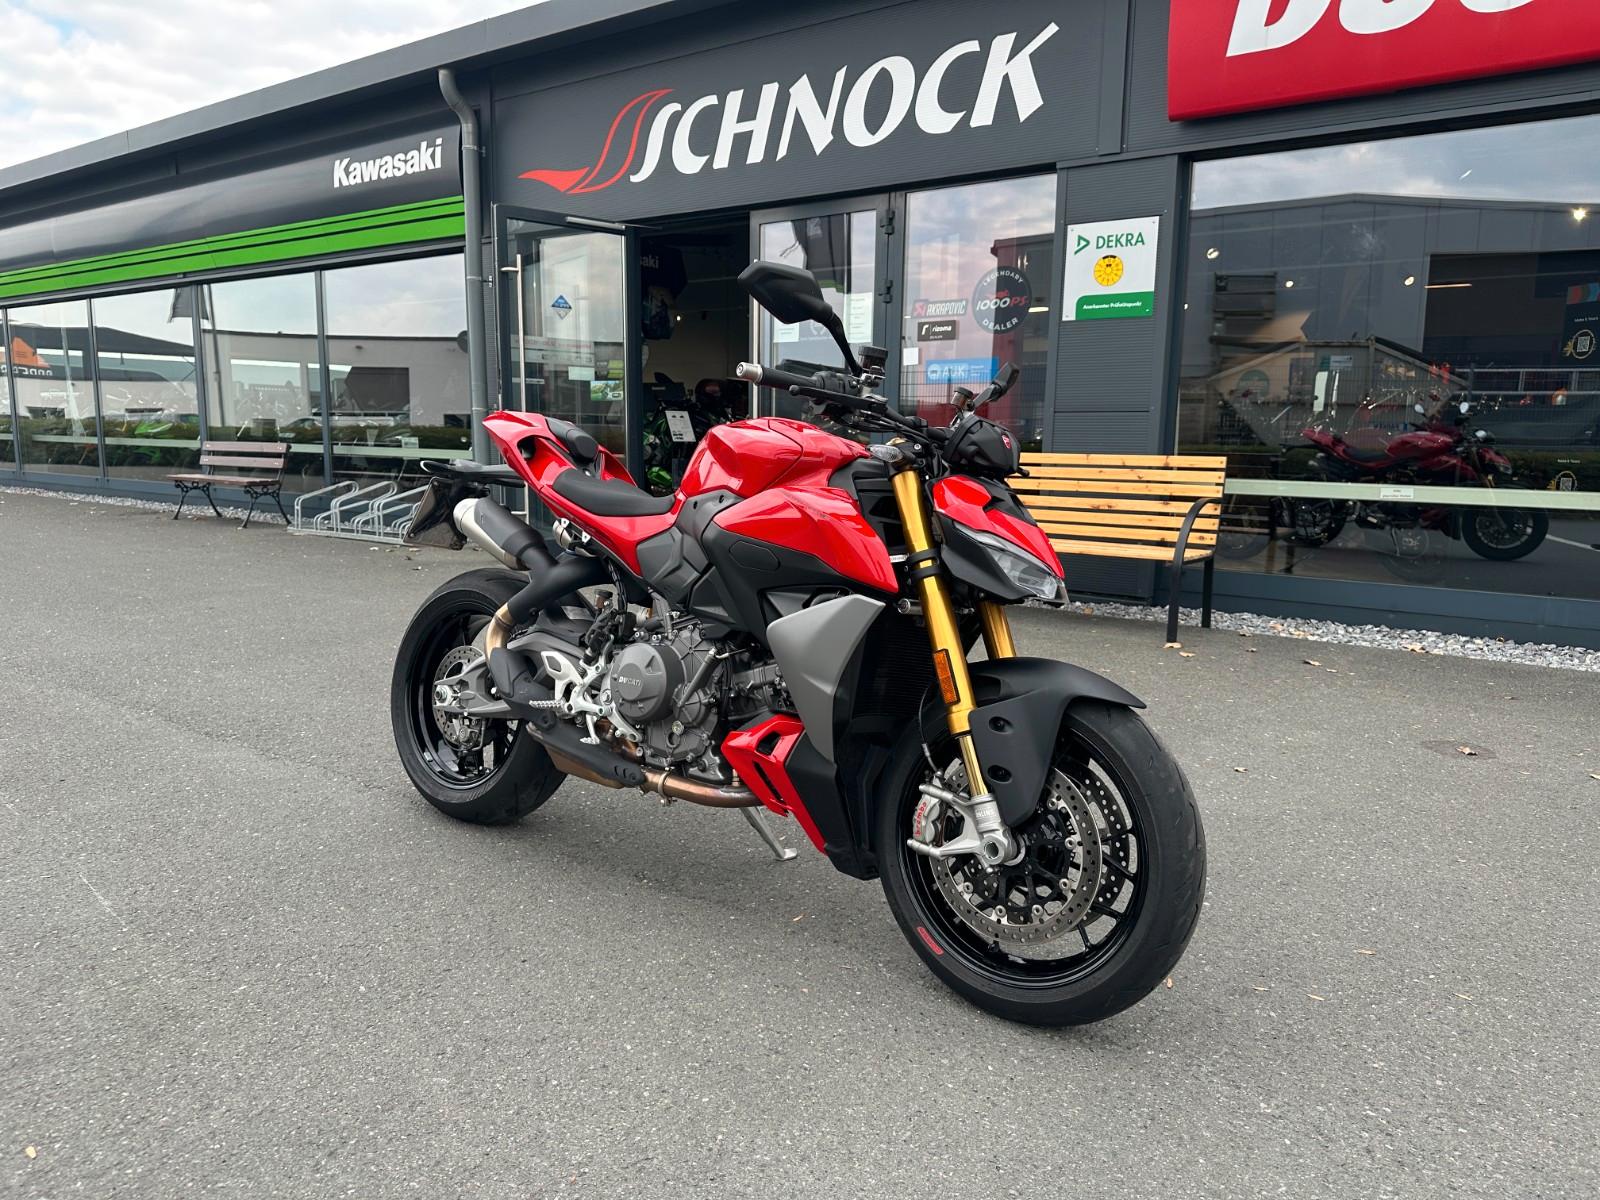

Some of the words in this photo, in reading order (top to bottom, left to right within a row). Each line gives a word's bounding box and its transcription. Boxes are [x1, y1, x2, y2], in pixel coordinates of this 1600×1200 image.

[629, 22, 1060, 183] SCHNOCK
[333, 137, 443, 189] Kawasaki
[1095, 231, 1146, 250] DEKRA
[983, 270, 1024, 286] LEGENDARY
[982, 317, 1019, 331] DEALER
[914, 801, 928, 837] brembo
